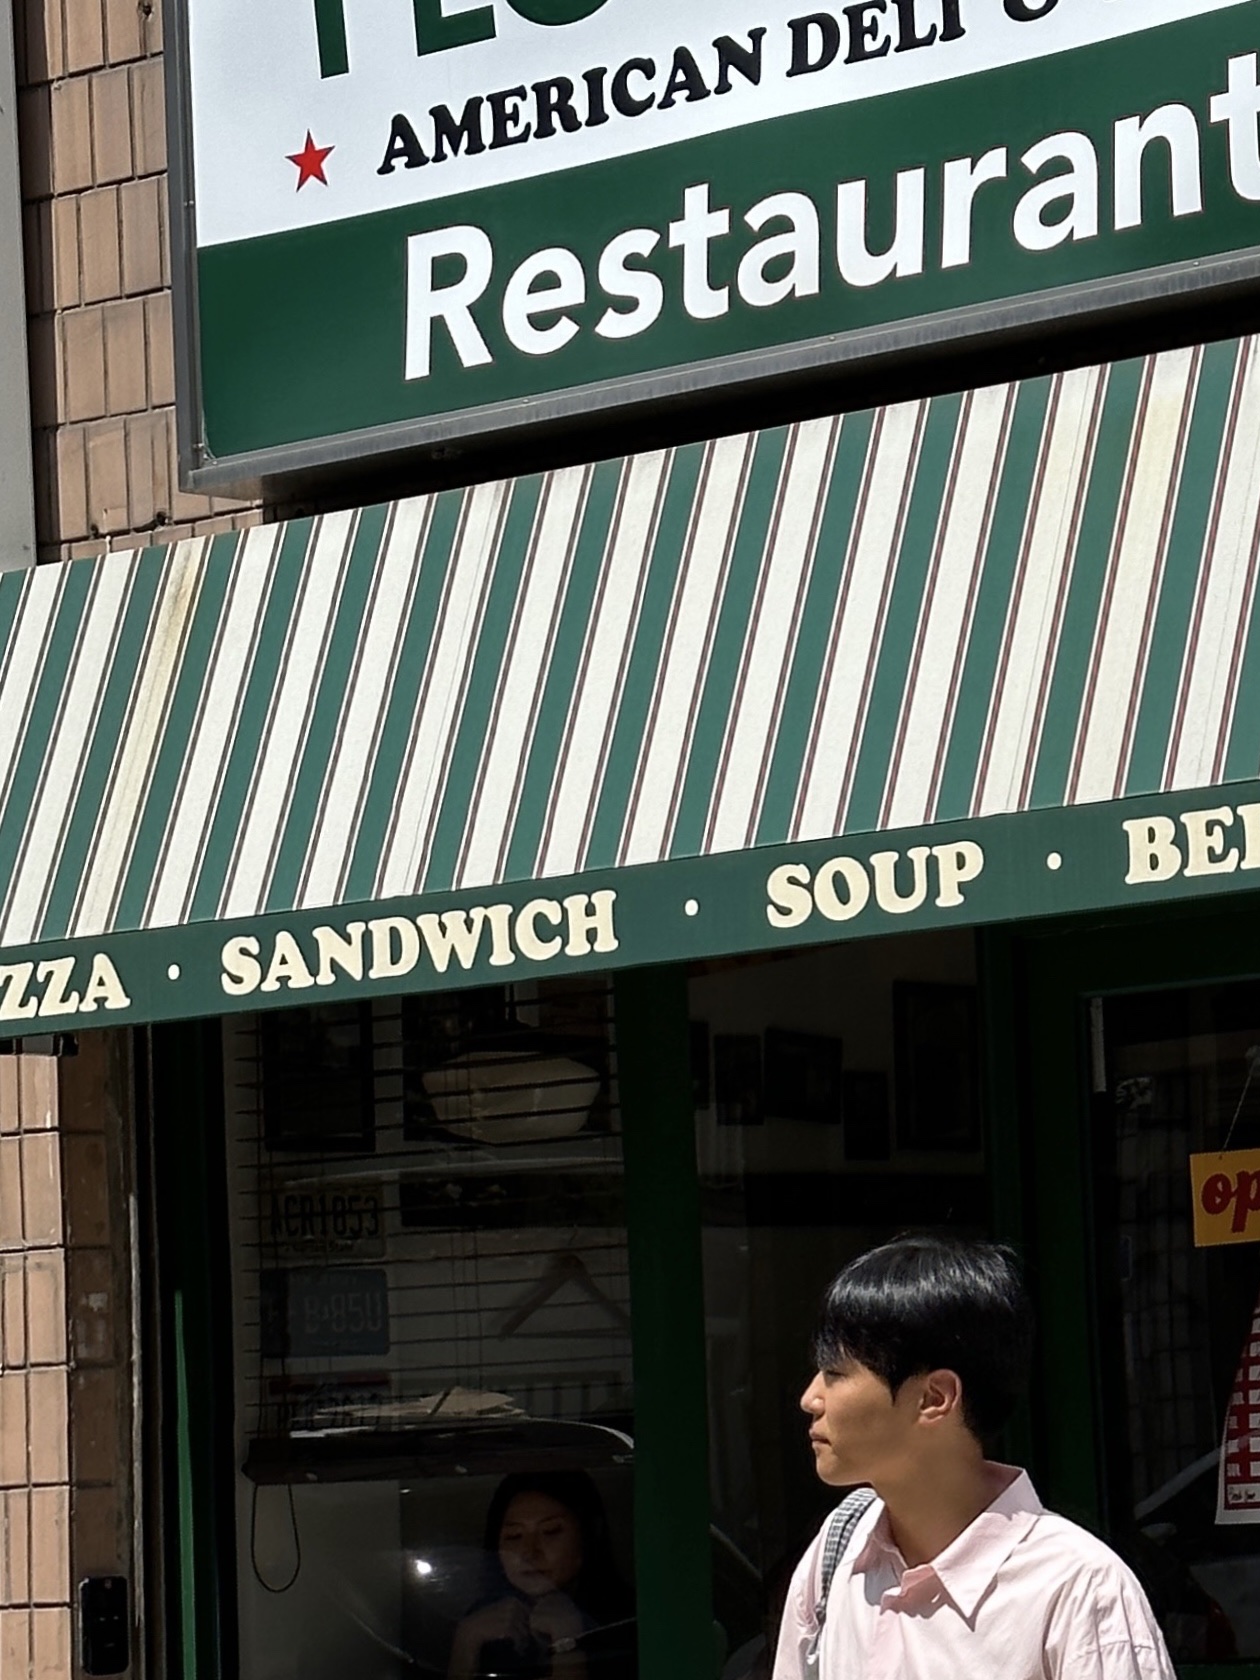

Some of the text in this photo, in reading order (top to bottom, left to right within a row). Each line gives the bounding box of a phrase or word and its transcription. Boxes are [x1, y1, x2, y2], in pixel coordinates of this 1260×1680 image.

[377, 26, 768, 176] AMERICAN
[786, 0, 967, 78] DELI
[0, 953, 131, 1021] ZZA
[220, 889, 619, 996] SANDWICH
[766, 841, 985, 929] SOUP
